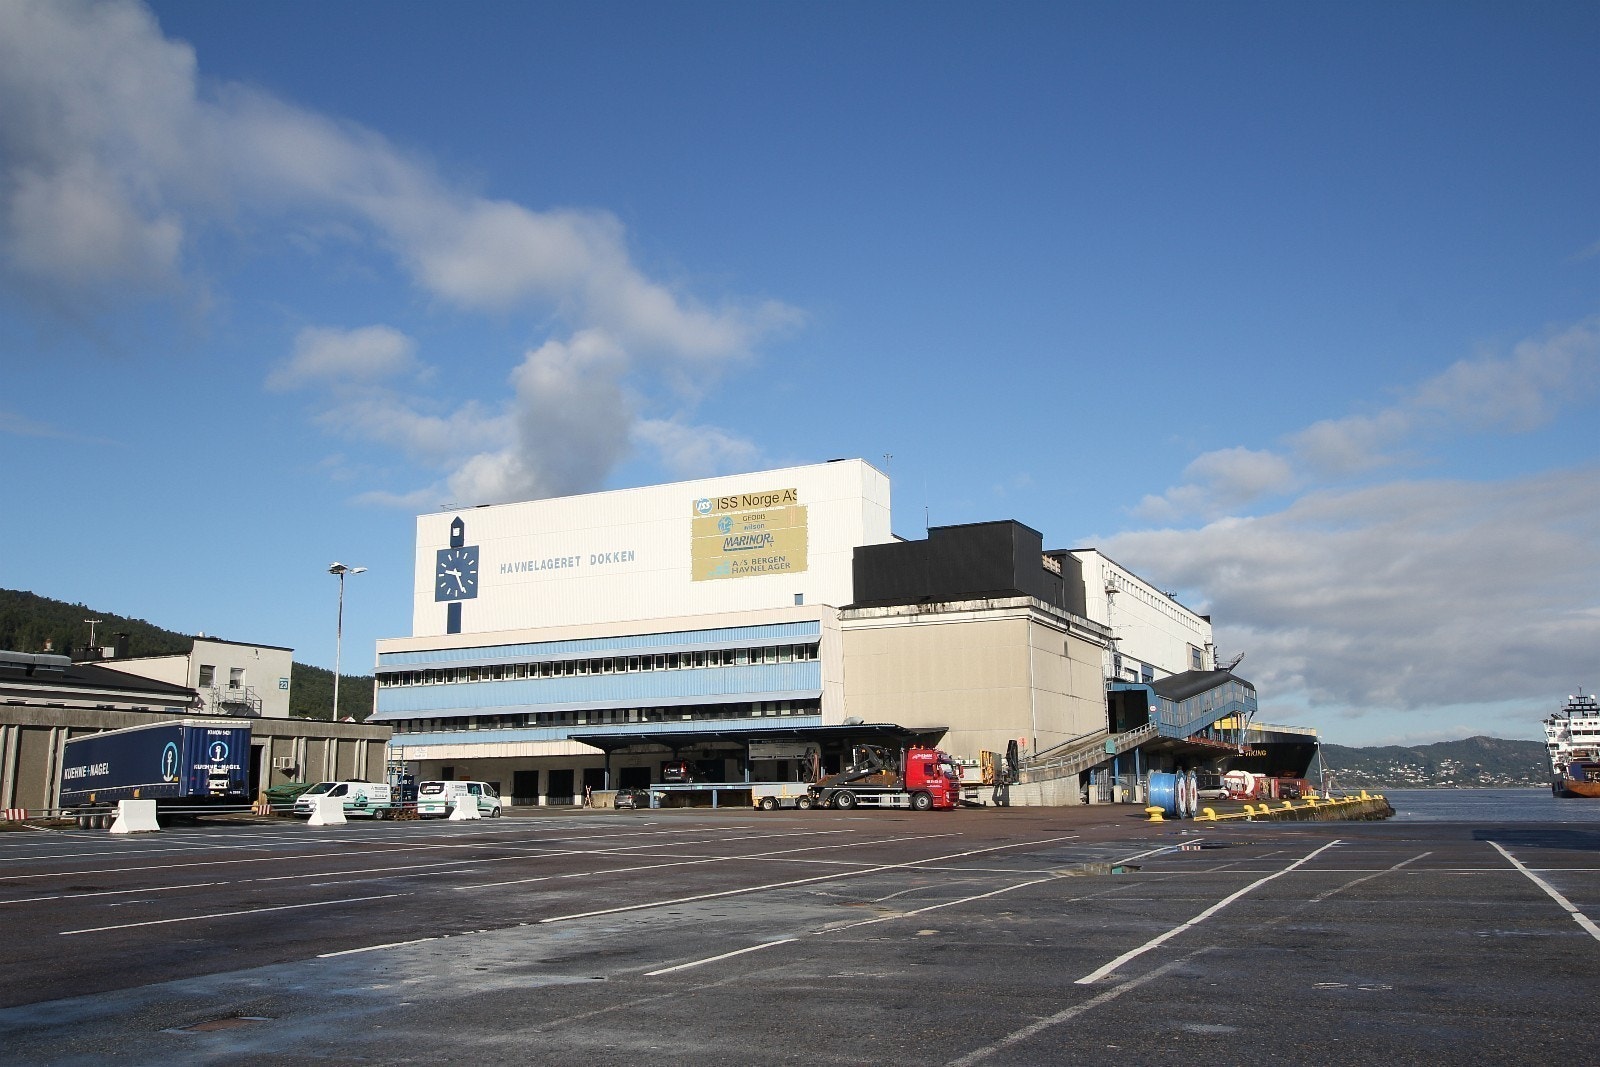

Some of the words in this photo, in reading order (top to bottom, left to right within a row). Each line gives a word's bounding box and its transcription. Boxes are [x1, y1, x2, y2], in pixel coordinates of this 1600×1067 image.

[717, 496, 738, 510] ISS
[742, 494, 779, 508] Norge
[723, 533, 770, 549] MARINOR
[500, 555, 581, 574] HAVNELAGERET
[590, 550, 635, 566] DOKKEN
[751, 555, 786, 566] BERGEN
[731, 562, 791, 574] HAVNELAGER
[1245, 749, 1267, 757] VIKING
